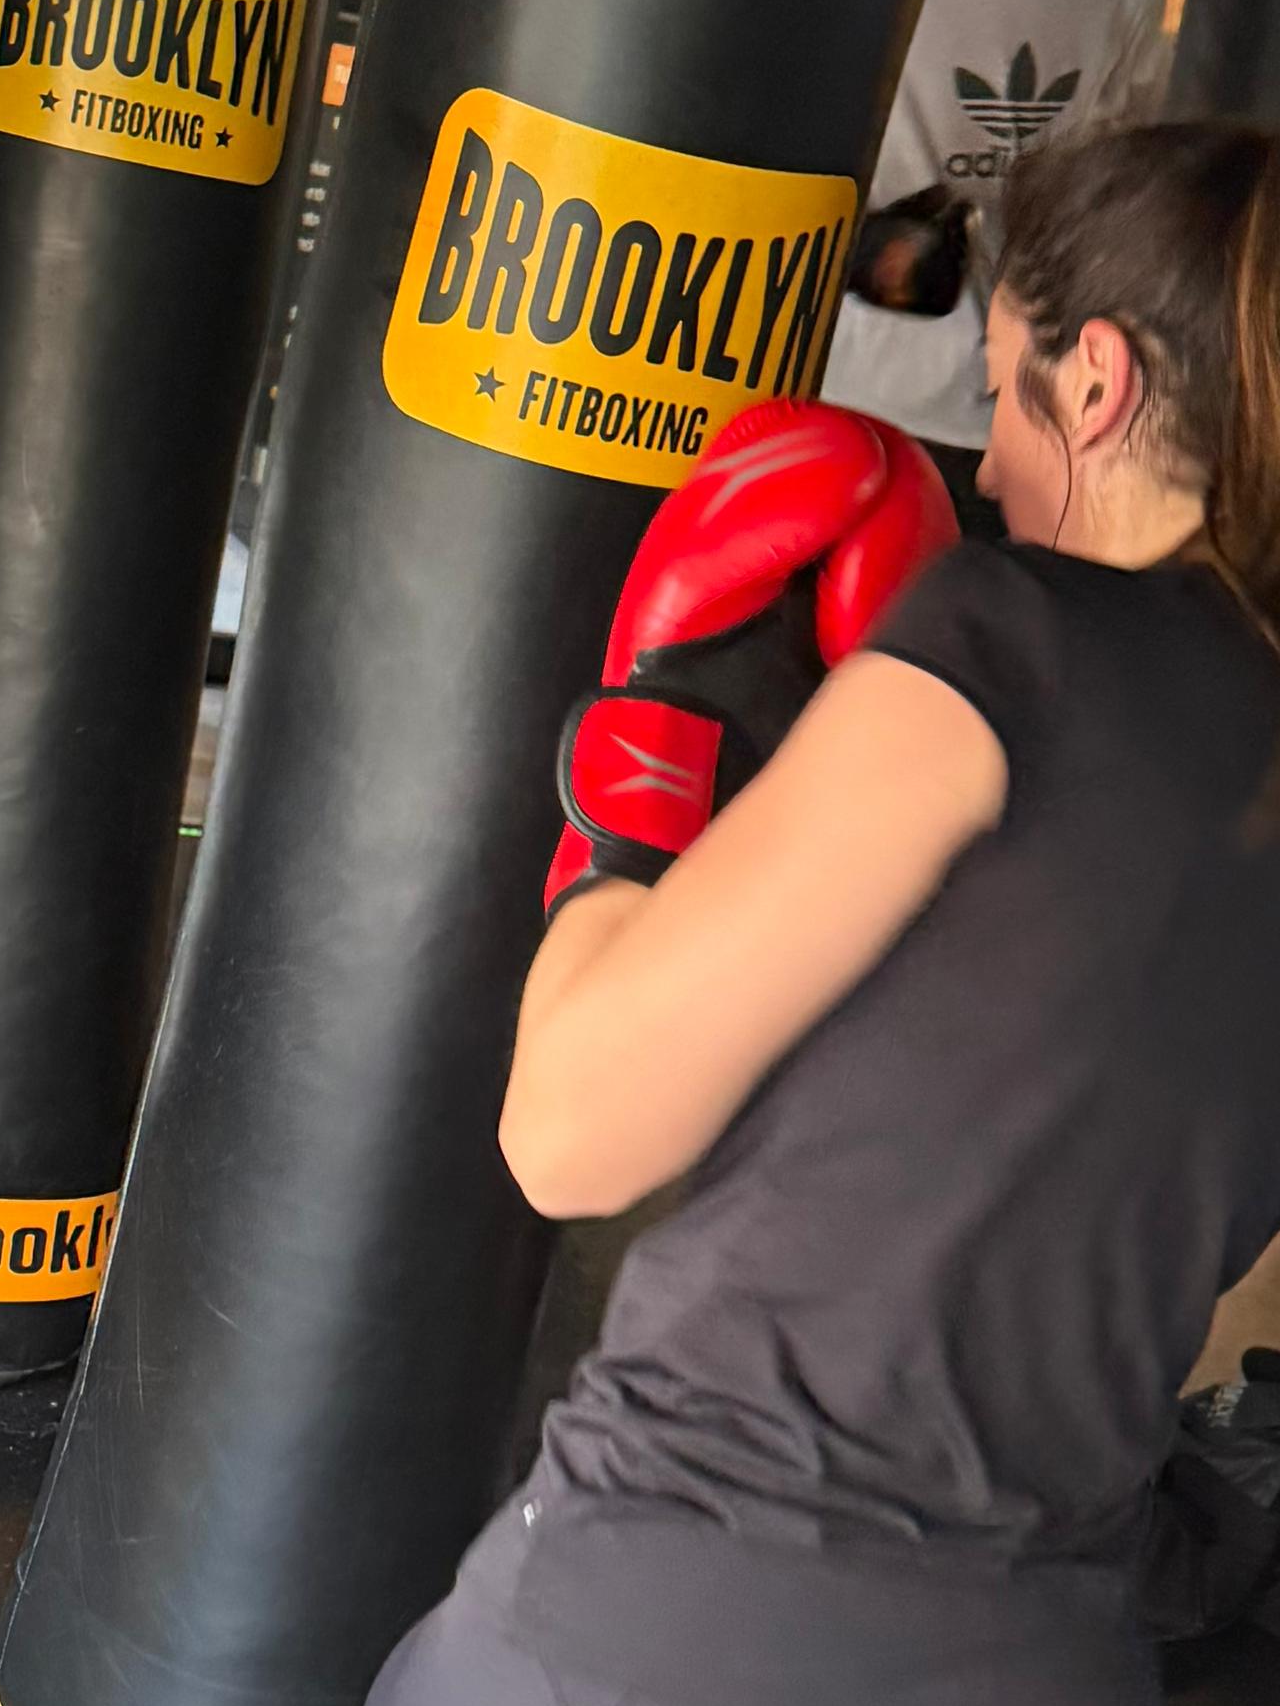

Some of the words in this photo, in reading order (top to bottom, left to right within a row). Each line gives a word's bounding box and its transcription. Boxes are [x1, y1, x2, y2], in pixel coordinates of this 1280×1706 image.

[70, 88, 205, 151] FITBOXING
[417, 125, 846, 401] BROOKLYN
[518, 370, 709, 458] FITBOXING
